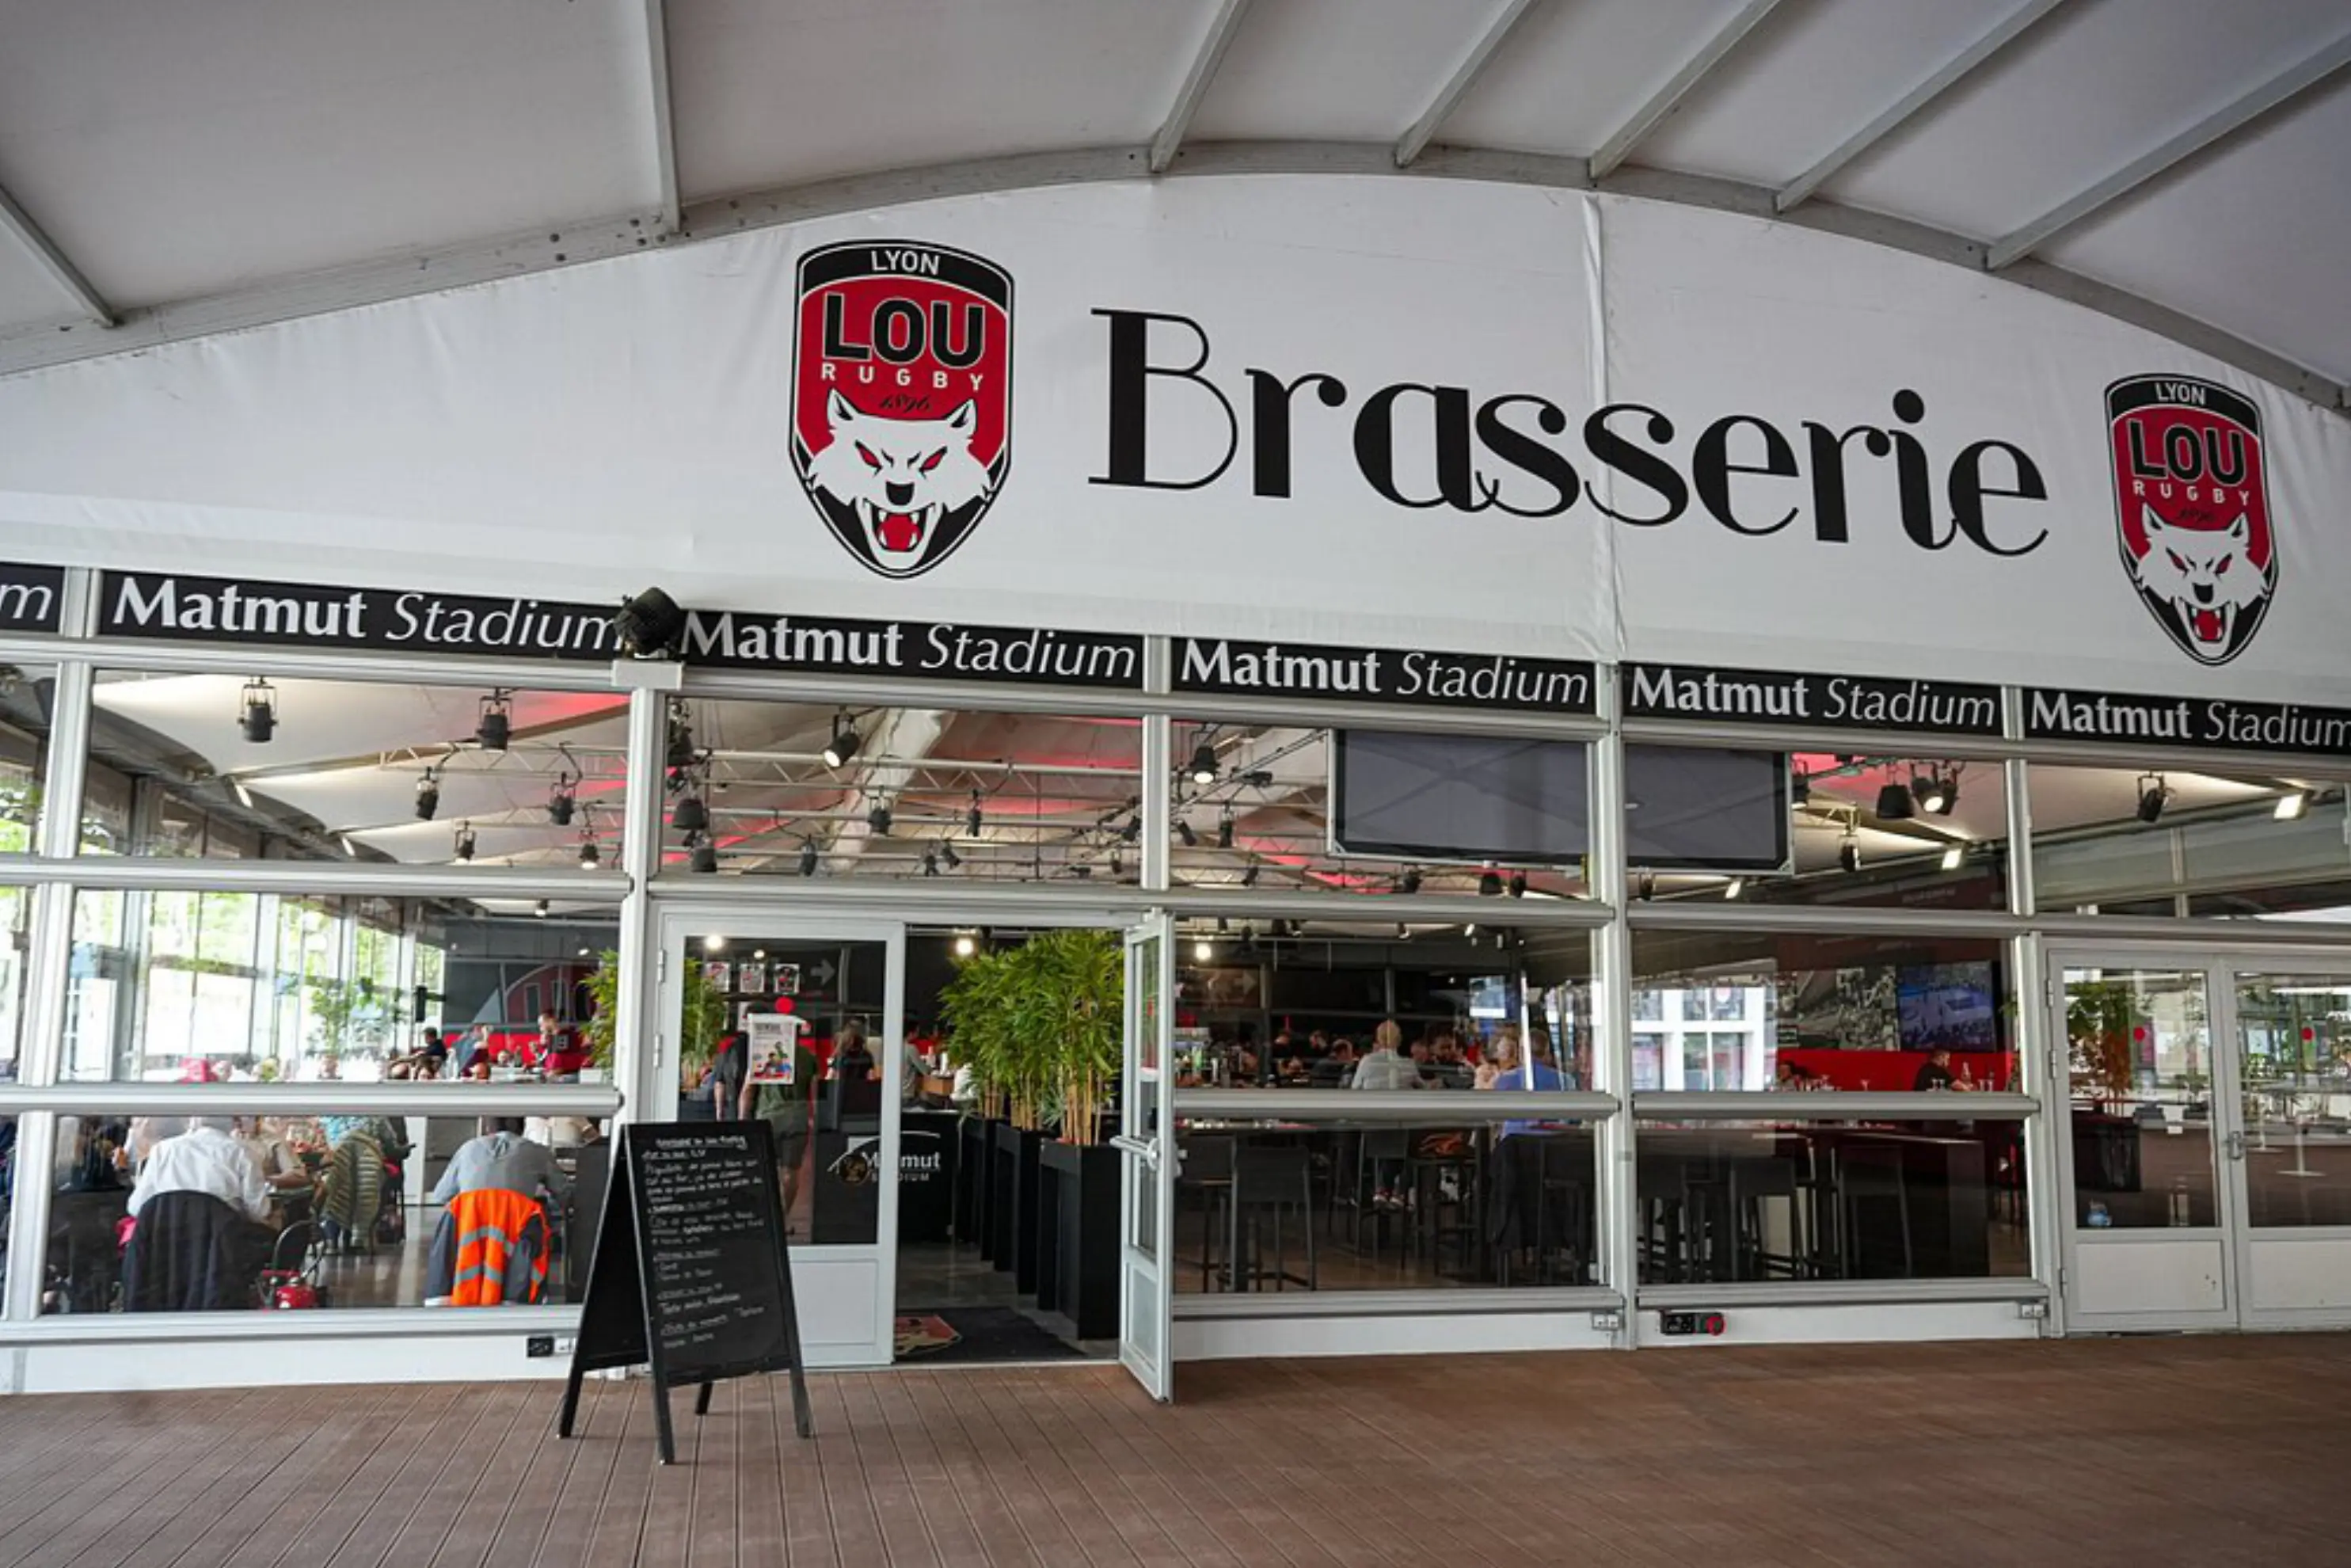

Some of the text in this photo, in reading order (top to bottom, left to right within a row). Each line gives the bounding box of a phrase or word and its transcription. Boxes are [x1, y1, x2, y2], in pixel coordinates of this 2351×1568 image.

[871, 249, 941, 276] LYON
[822, 291, 986, 369] LOU
[821, 363, 983, 392] RUGBY
[2154, 382, 2207, 406] LYON
[1089, 308, 2049, 556] Brasserie
[2126, 418, 2246, 488] LOU
[2133, 480, 2250, 507] RUGBY
[112, 576, 367, 639] Matmut
[385, 592, 624, 650] Stadium
[680, 610, 1136, 678] Matmut Stadium
[1181, 638, 1589, 704] Matmut Stadium
[1631, 666, 1995, 727] Matmut Stadium
[2030, 691, 2351, 747] Matmut Stadium
[861, 1151, 941, 1172] Mmut
